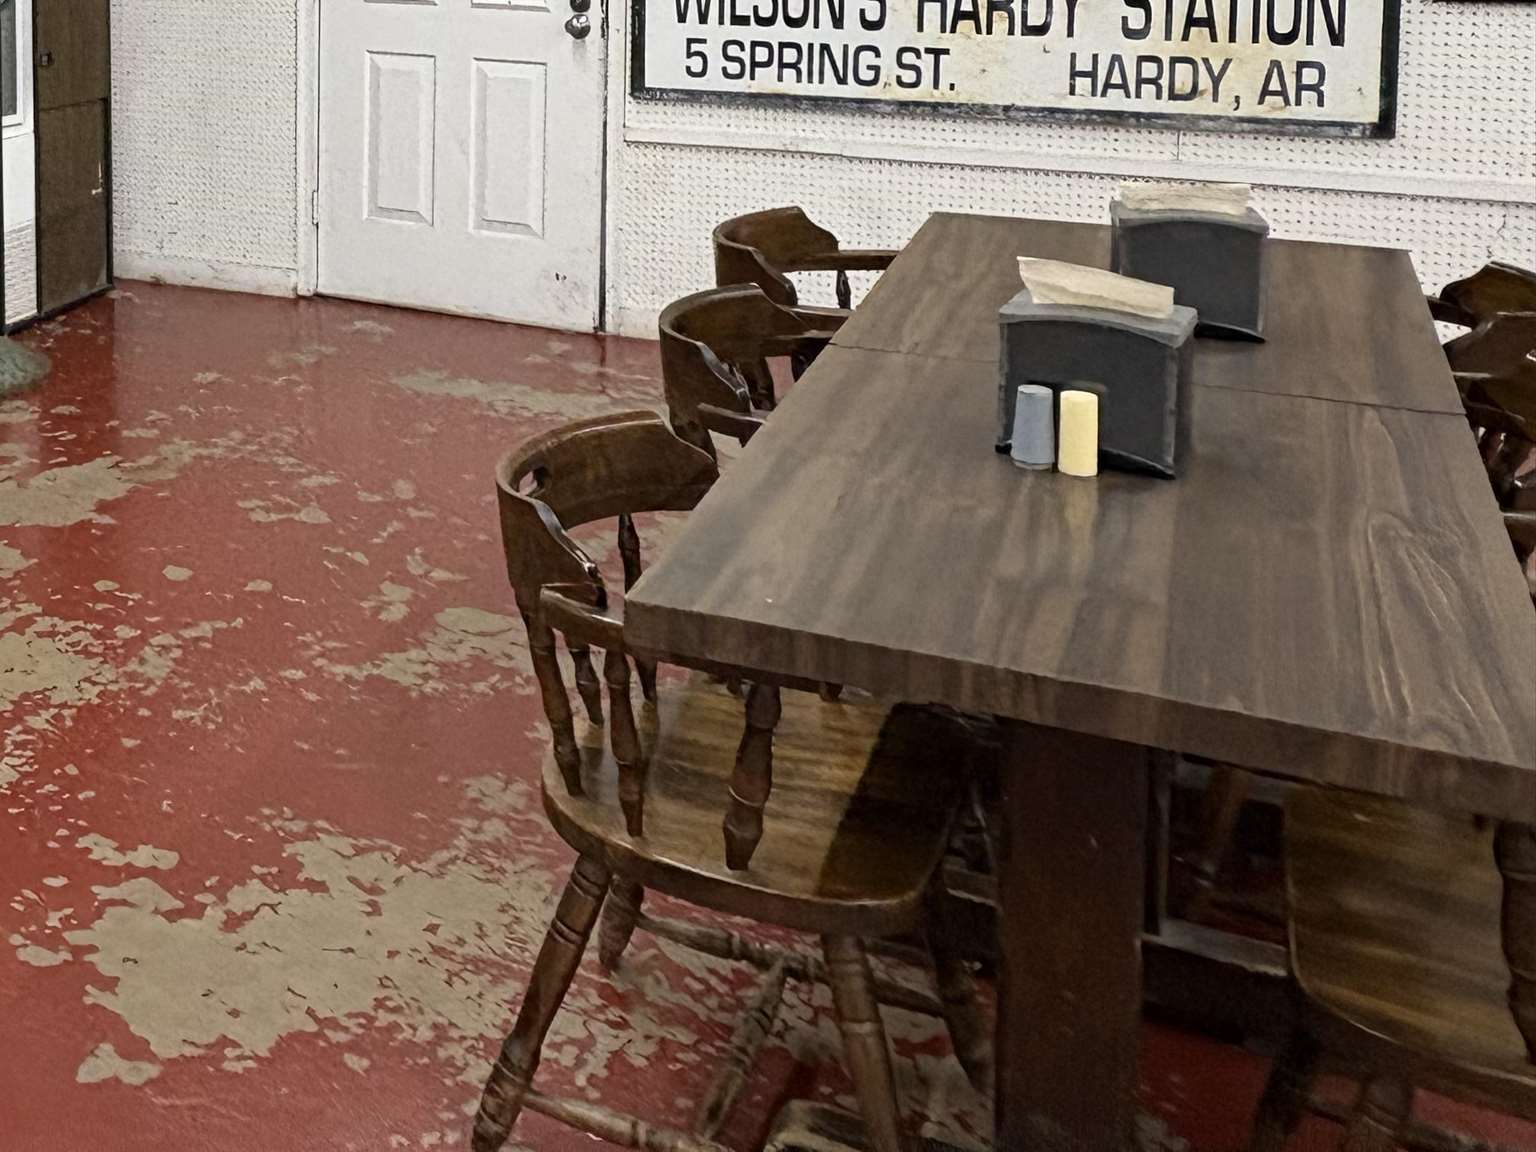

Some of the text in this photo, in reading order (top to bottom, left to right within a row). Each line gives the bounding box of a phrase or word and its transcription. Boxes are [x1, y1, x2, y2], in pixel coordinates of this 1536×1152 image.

[684, 38, 1326, 111] 5 SPRING ST. HARDY, AR
